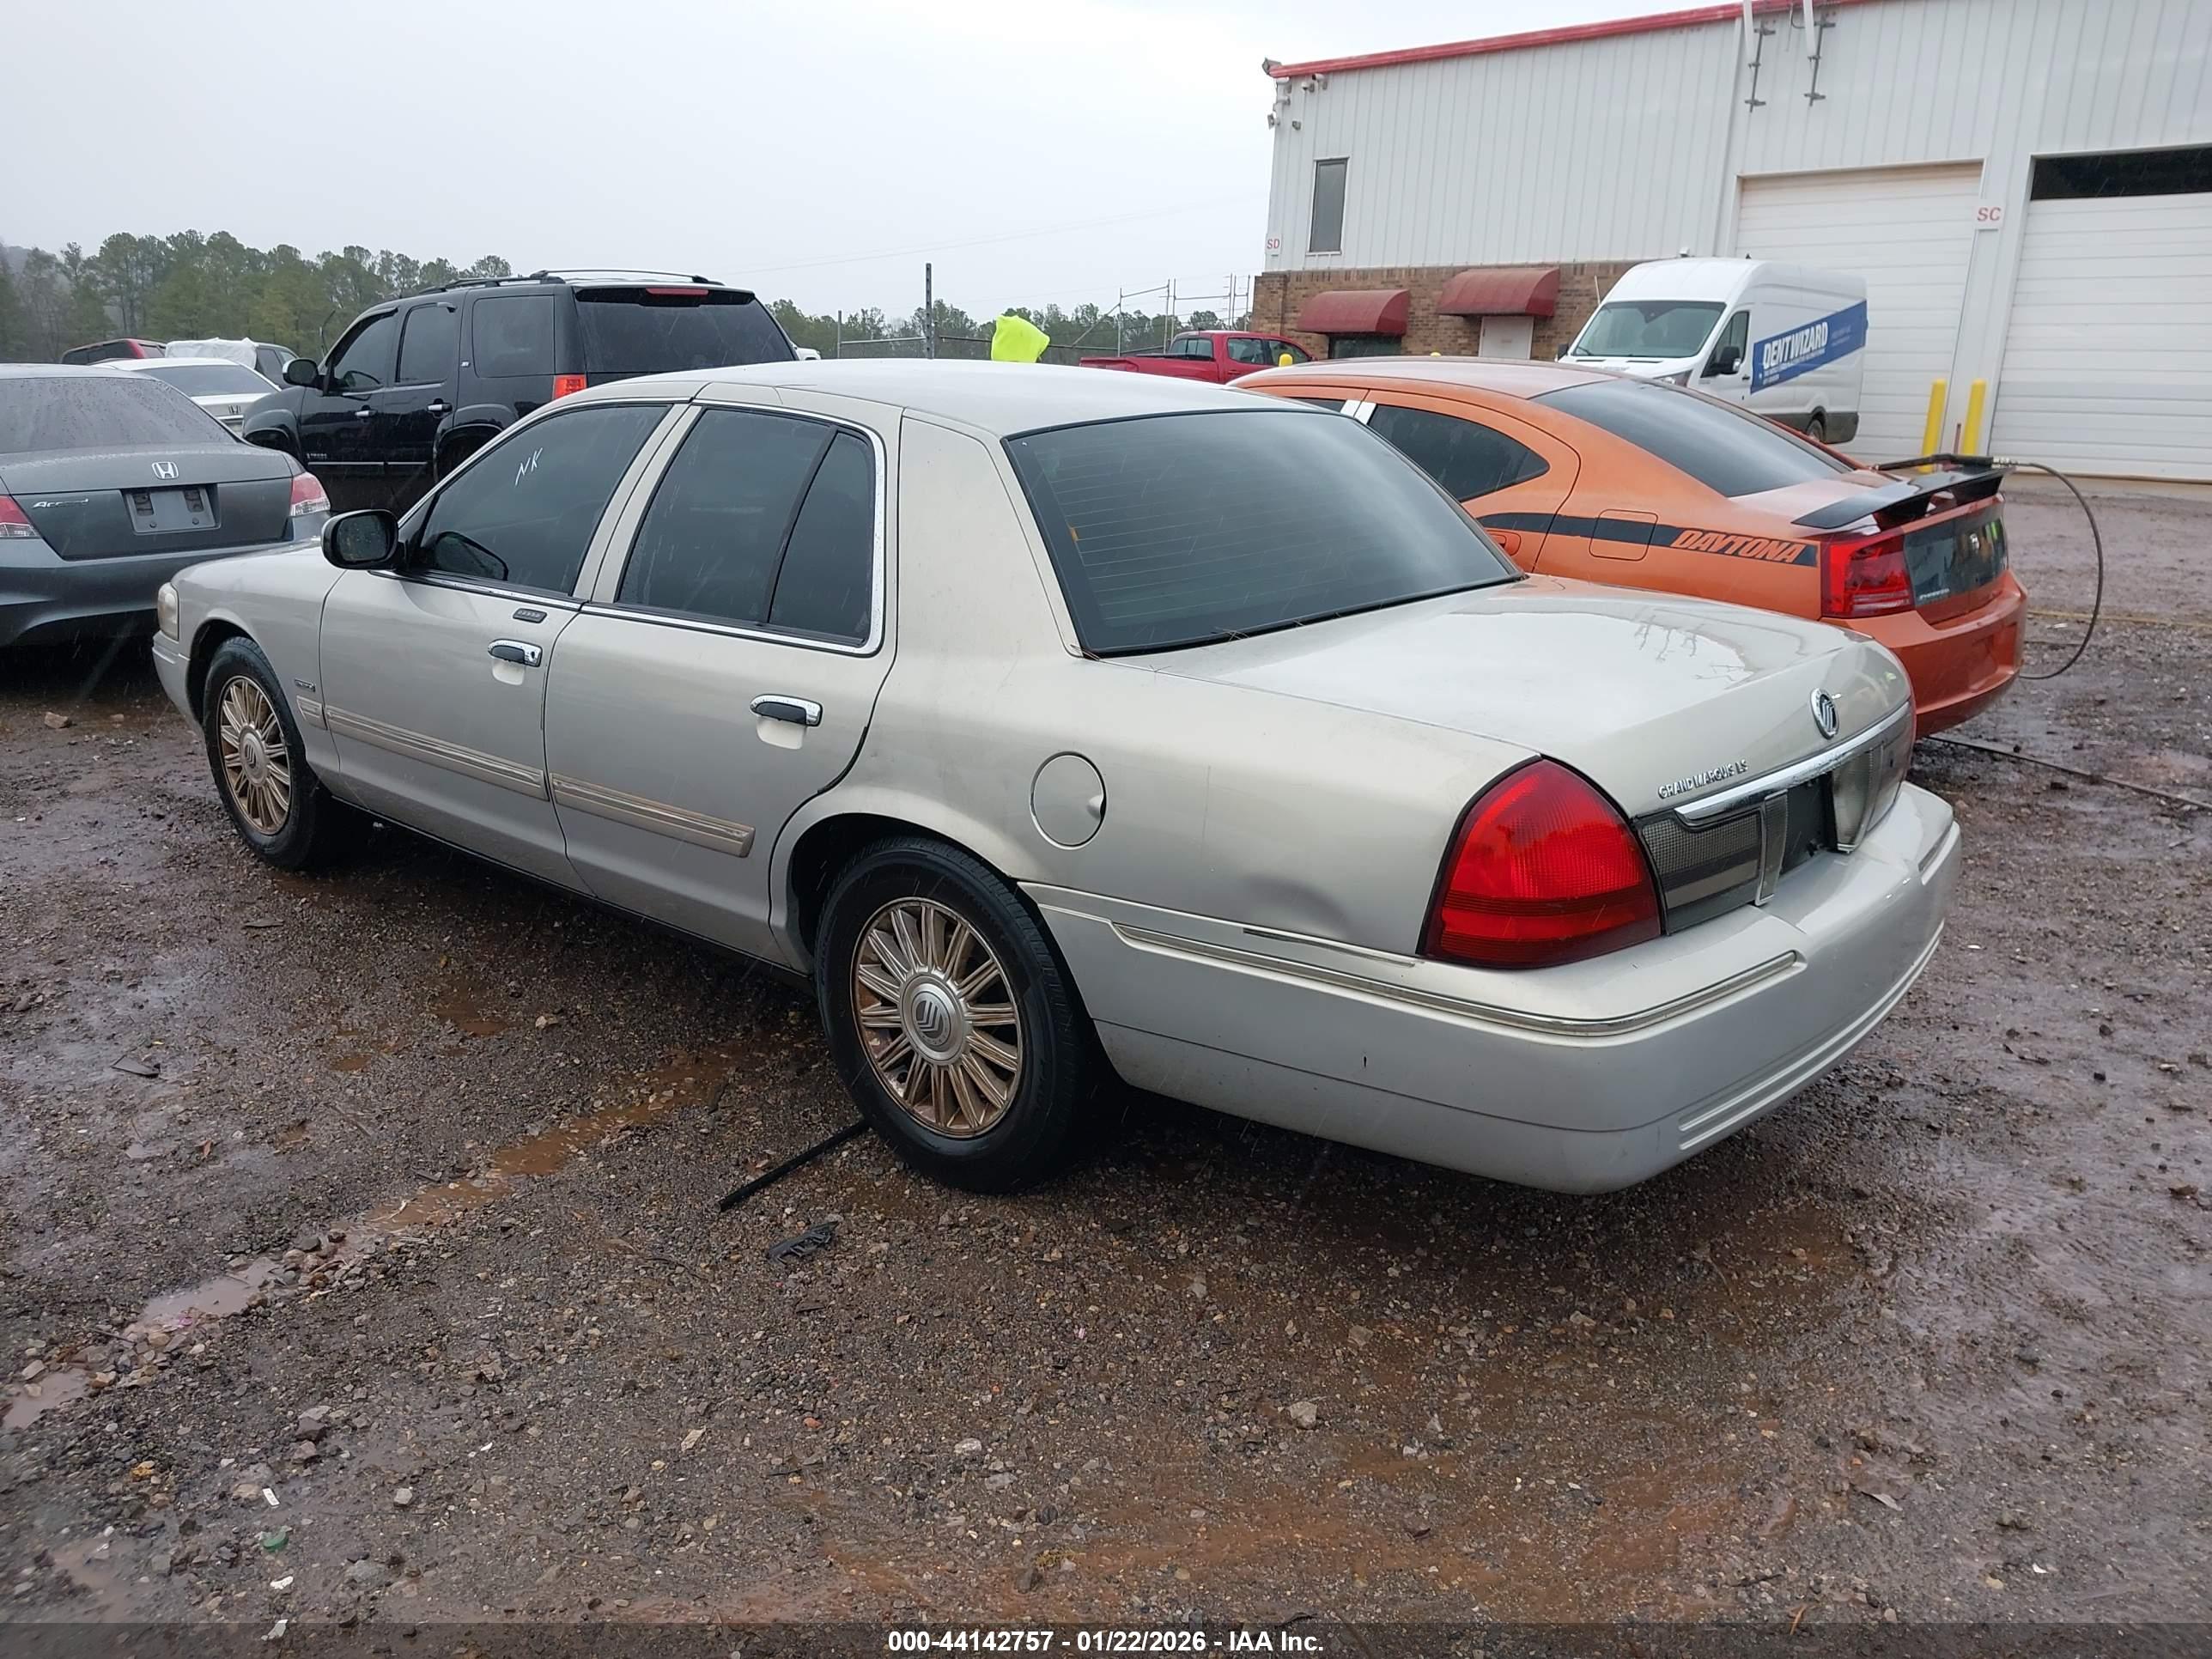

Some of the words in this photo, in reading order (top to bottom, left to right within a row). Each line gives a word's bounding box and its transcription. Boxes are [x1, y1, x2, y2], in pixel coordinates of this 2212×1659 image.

[1977, 207, 2002, 222] SC
[1267, 239, 1280, 249] SD
[1670, 529, 1807, 563] DAYTONA
